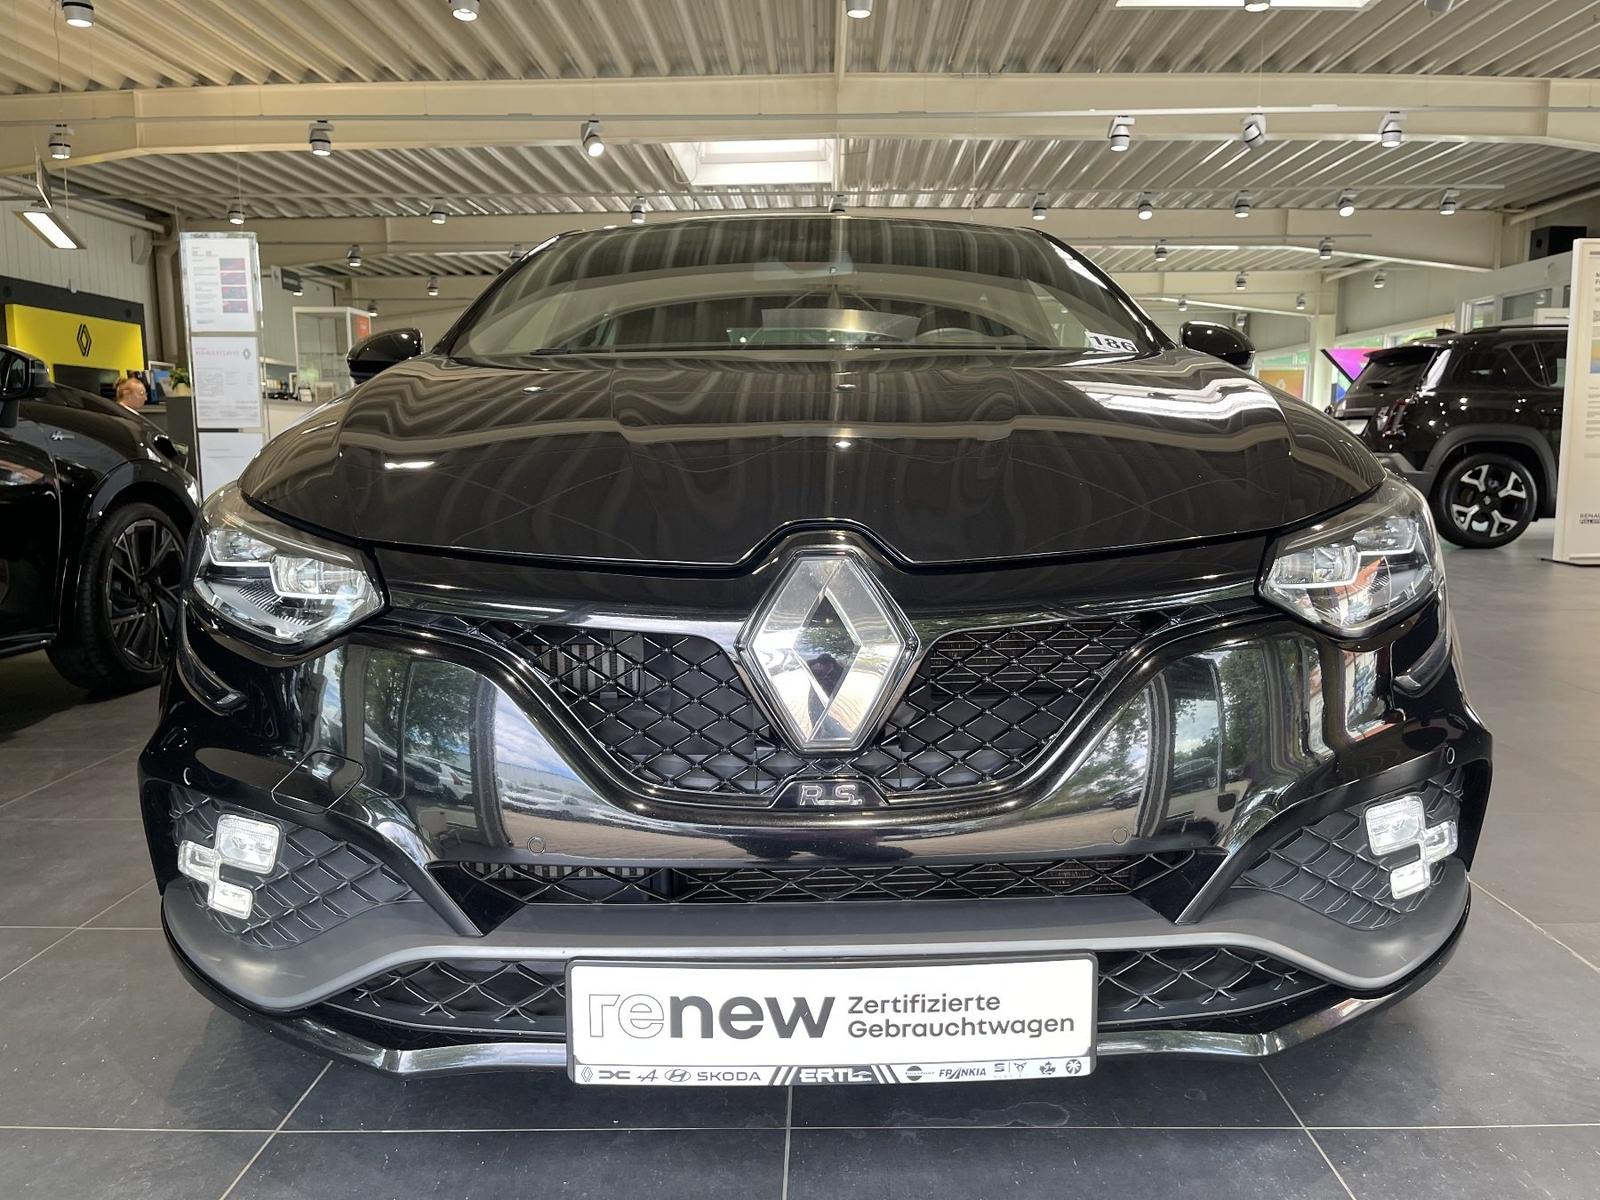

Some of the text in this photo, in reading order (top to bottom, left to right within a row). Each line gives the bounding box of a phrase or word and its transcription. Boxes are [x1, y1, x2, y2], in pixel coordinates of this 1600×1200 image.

[847, 993, 1001, 1015] Zertifizierte
[588, 993, 836, 1040] renew
[847, 1016, 1075, 1039] Gebrauchtwagen
[696, 1071, 762, 1082] SKODA
[799, 1067, 873, 1083] ERTL
